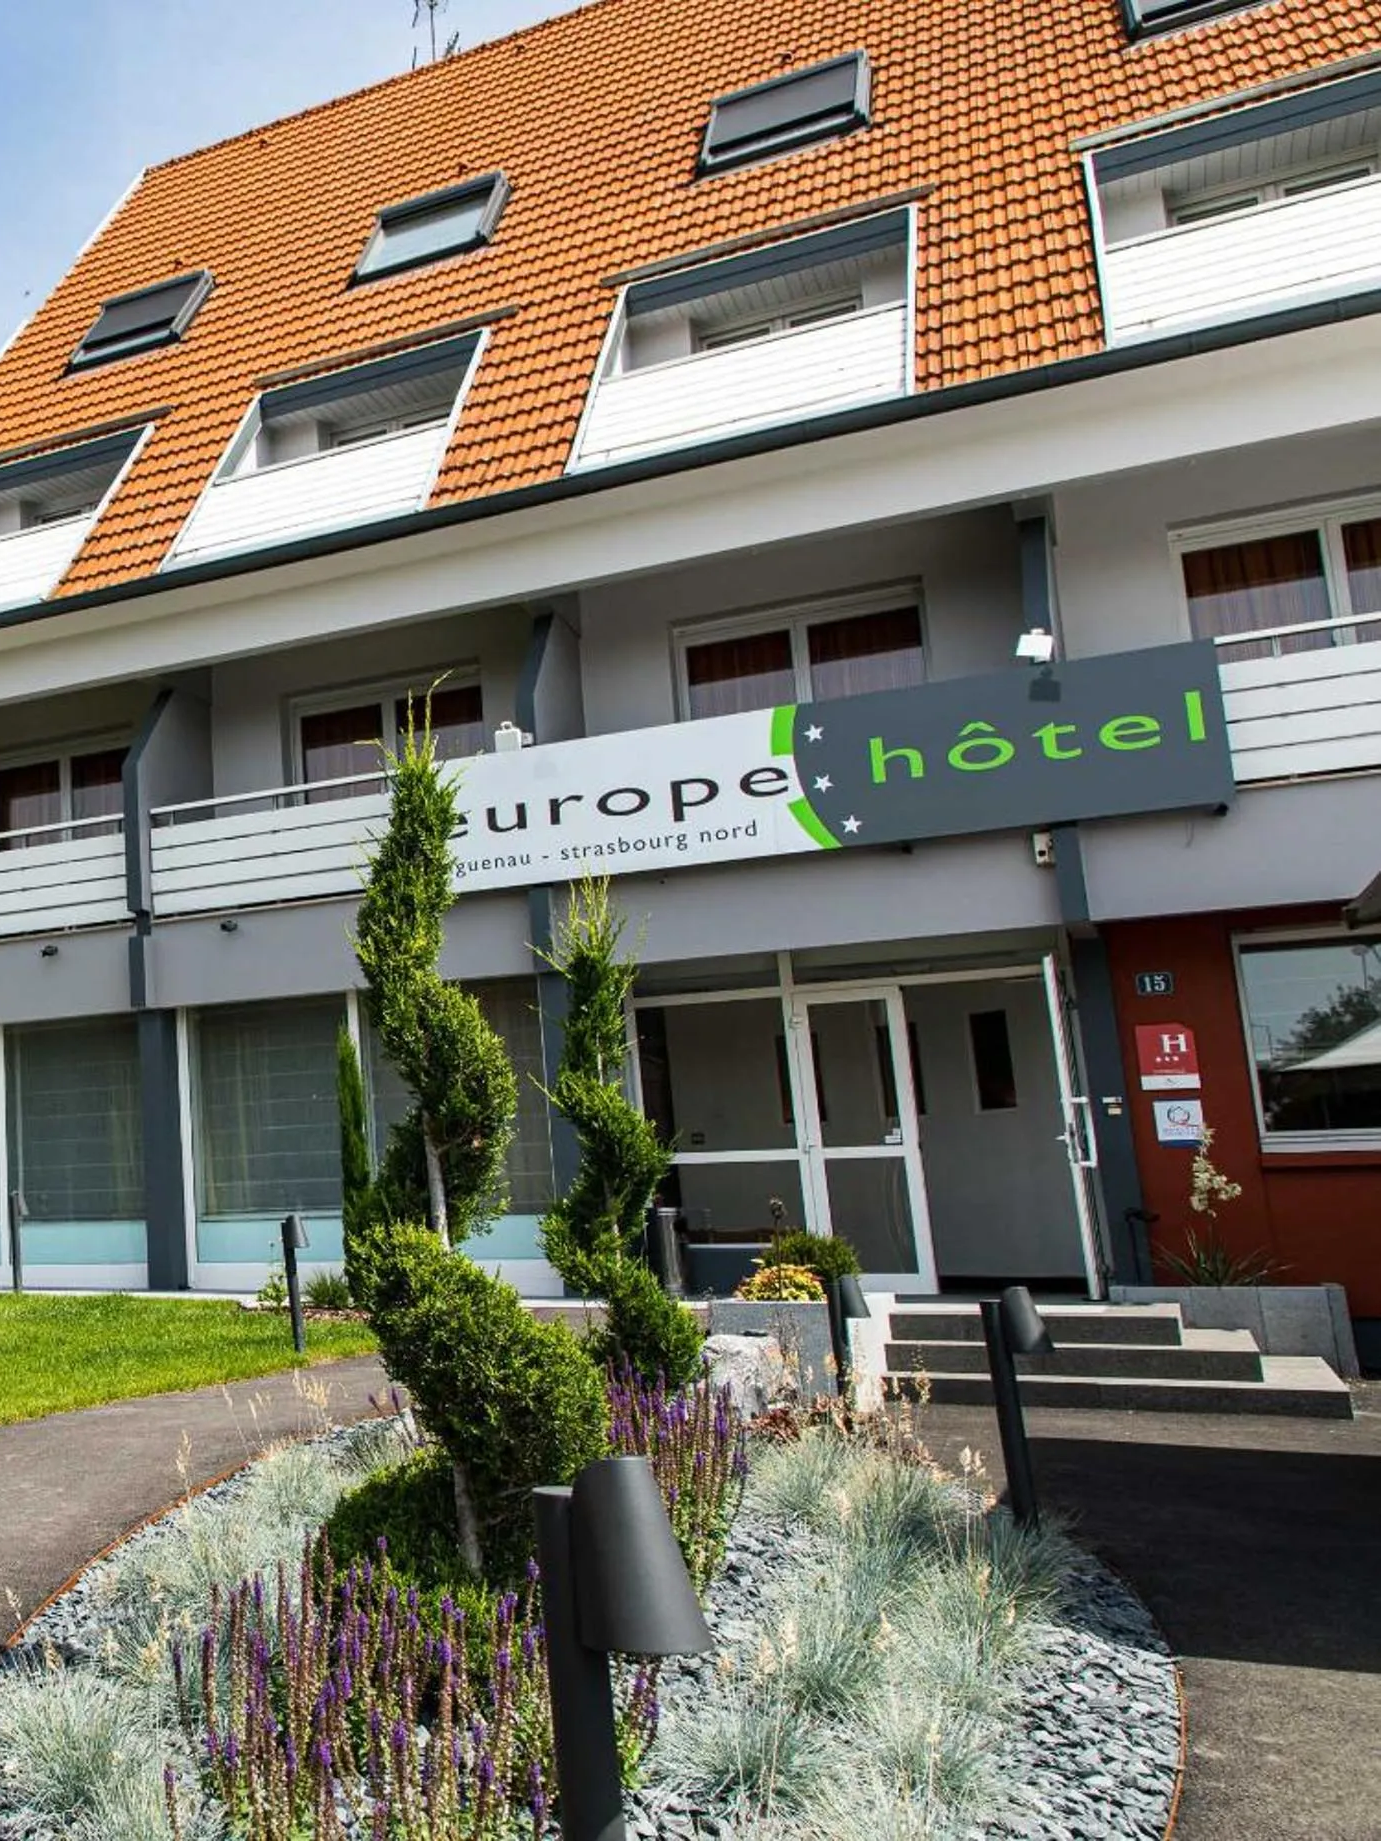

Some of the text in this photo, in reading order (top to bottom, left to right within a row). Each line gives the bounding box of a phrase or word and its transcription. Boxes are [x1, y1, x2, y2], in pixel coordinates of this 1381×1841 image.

[869, 690, 1206, 784] hôtel
[455, 853, 532, 878] guenau
[560, 833, 689, 861] strasbourg
[699, 820, 758, 844] nord
[1144, 975, 1166, 993] 15
[1161, 1034, 1189, 1053] H
